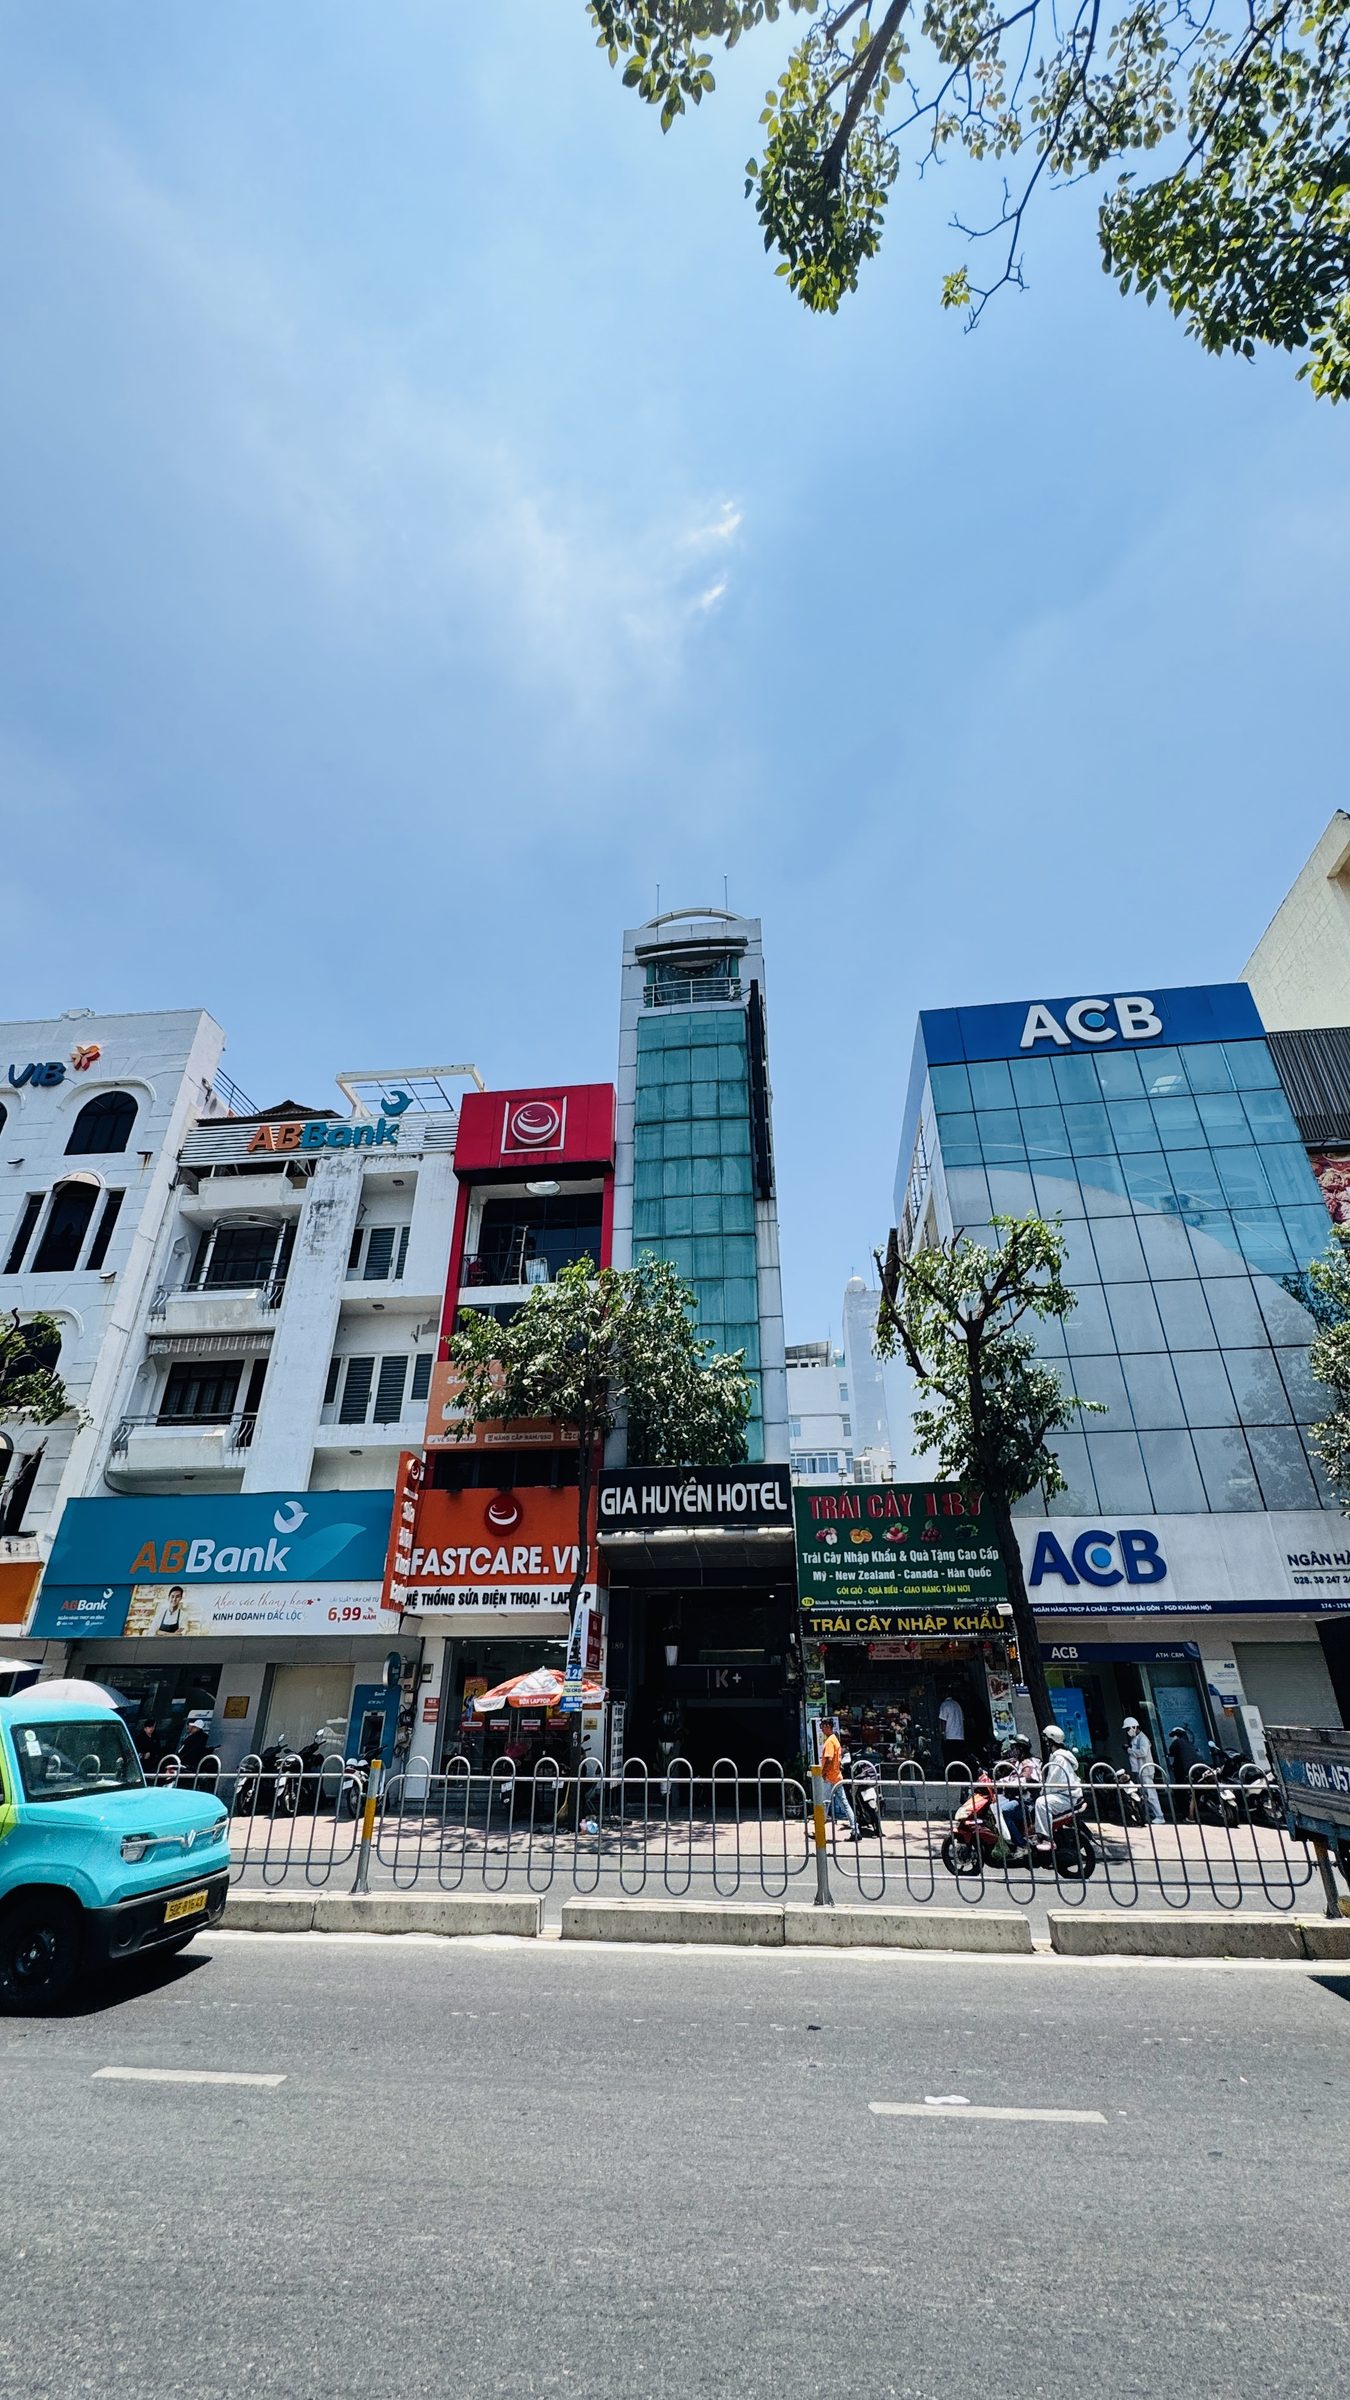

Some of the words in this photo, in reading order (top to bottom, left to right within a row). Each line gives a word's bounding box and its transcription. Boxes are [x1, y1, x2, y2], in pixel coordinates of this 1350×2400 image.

[1020, 997, 1163, 1048] ACB
[8, 1062, 67, 1088] VIB
[247, 1117, 400, 1152] ABBank
[601, 1486, 638, 1516] GIA
[717, 1481, 788, 1513] HOTEL
[808, 1491, 861, 1519] TRÁI
[867, 1489, 914, 1518] CÂY
[129, 1538, 292, 1574] ABBank
[802, 1551, 821, 1564] Trái
[823, 1551, 842, 1565] Cây
[844, 1551, 869, 1566] Nhập
[872, 1548, 897, 1563] Khẩu
[899, 1550, 908, 1562] &
[910, 1549, 929, 1563] Quà
[931, 1549, 956, 1564] Tặng
[957, 1549, 977, 1561] Cao
[979, 1545, 1000, 1561] Cấp
[1028, 1530, 1168, 1587] ACB
[1287, 1551, 1333, 1567] NGÂN
[813, 1570, 827, 1583] Mỹ
[835, 1571, 856, 1581] New
[858, 1570, 896, 1581] Zealand
[904, 1568, 939, 1580] Canada
[947, 1566, 966, 1579] Hàn
[968, 1565, 992, 1579] Quốc
[1325, 1575, 1341, 1584] 247
[421, 1587, 455, 1606] THỐNG
[458, 1587, 479, 1606] SỬA
[482, 1589, 507, 1608] ĐIỆN
[511, 1591, 541, 1608] THOẠI
[551, 1591, 591, 1605] LAPP
[903, 1585, 920, 1594] GIAO
[921, 1585, 941, 1593] HÀNG
[61, 1599, 108, 1611] ABBank
[327, 1606, 362, 1623] 6,99
[1032, 1605, 1050, 1613] NGÂN
[1050, 1605, 1068, 1613] HÀNG
[1090, 1604, 1108, 1612] CHÂU
[212, 1612, 233, 1621] KINH
[234, 1612, 265, 1621] DOANH
[809, 1615, 851, 1632] TRÁI
[855, 1614, 892, 1631] CÂY
[897, 1614, 948, 1633] NHẬP
[953, 1609, 1005, 1630] KHẨU
[1051, 1646, 1079, 1659] ACB
